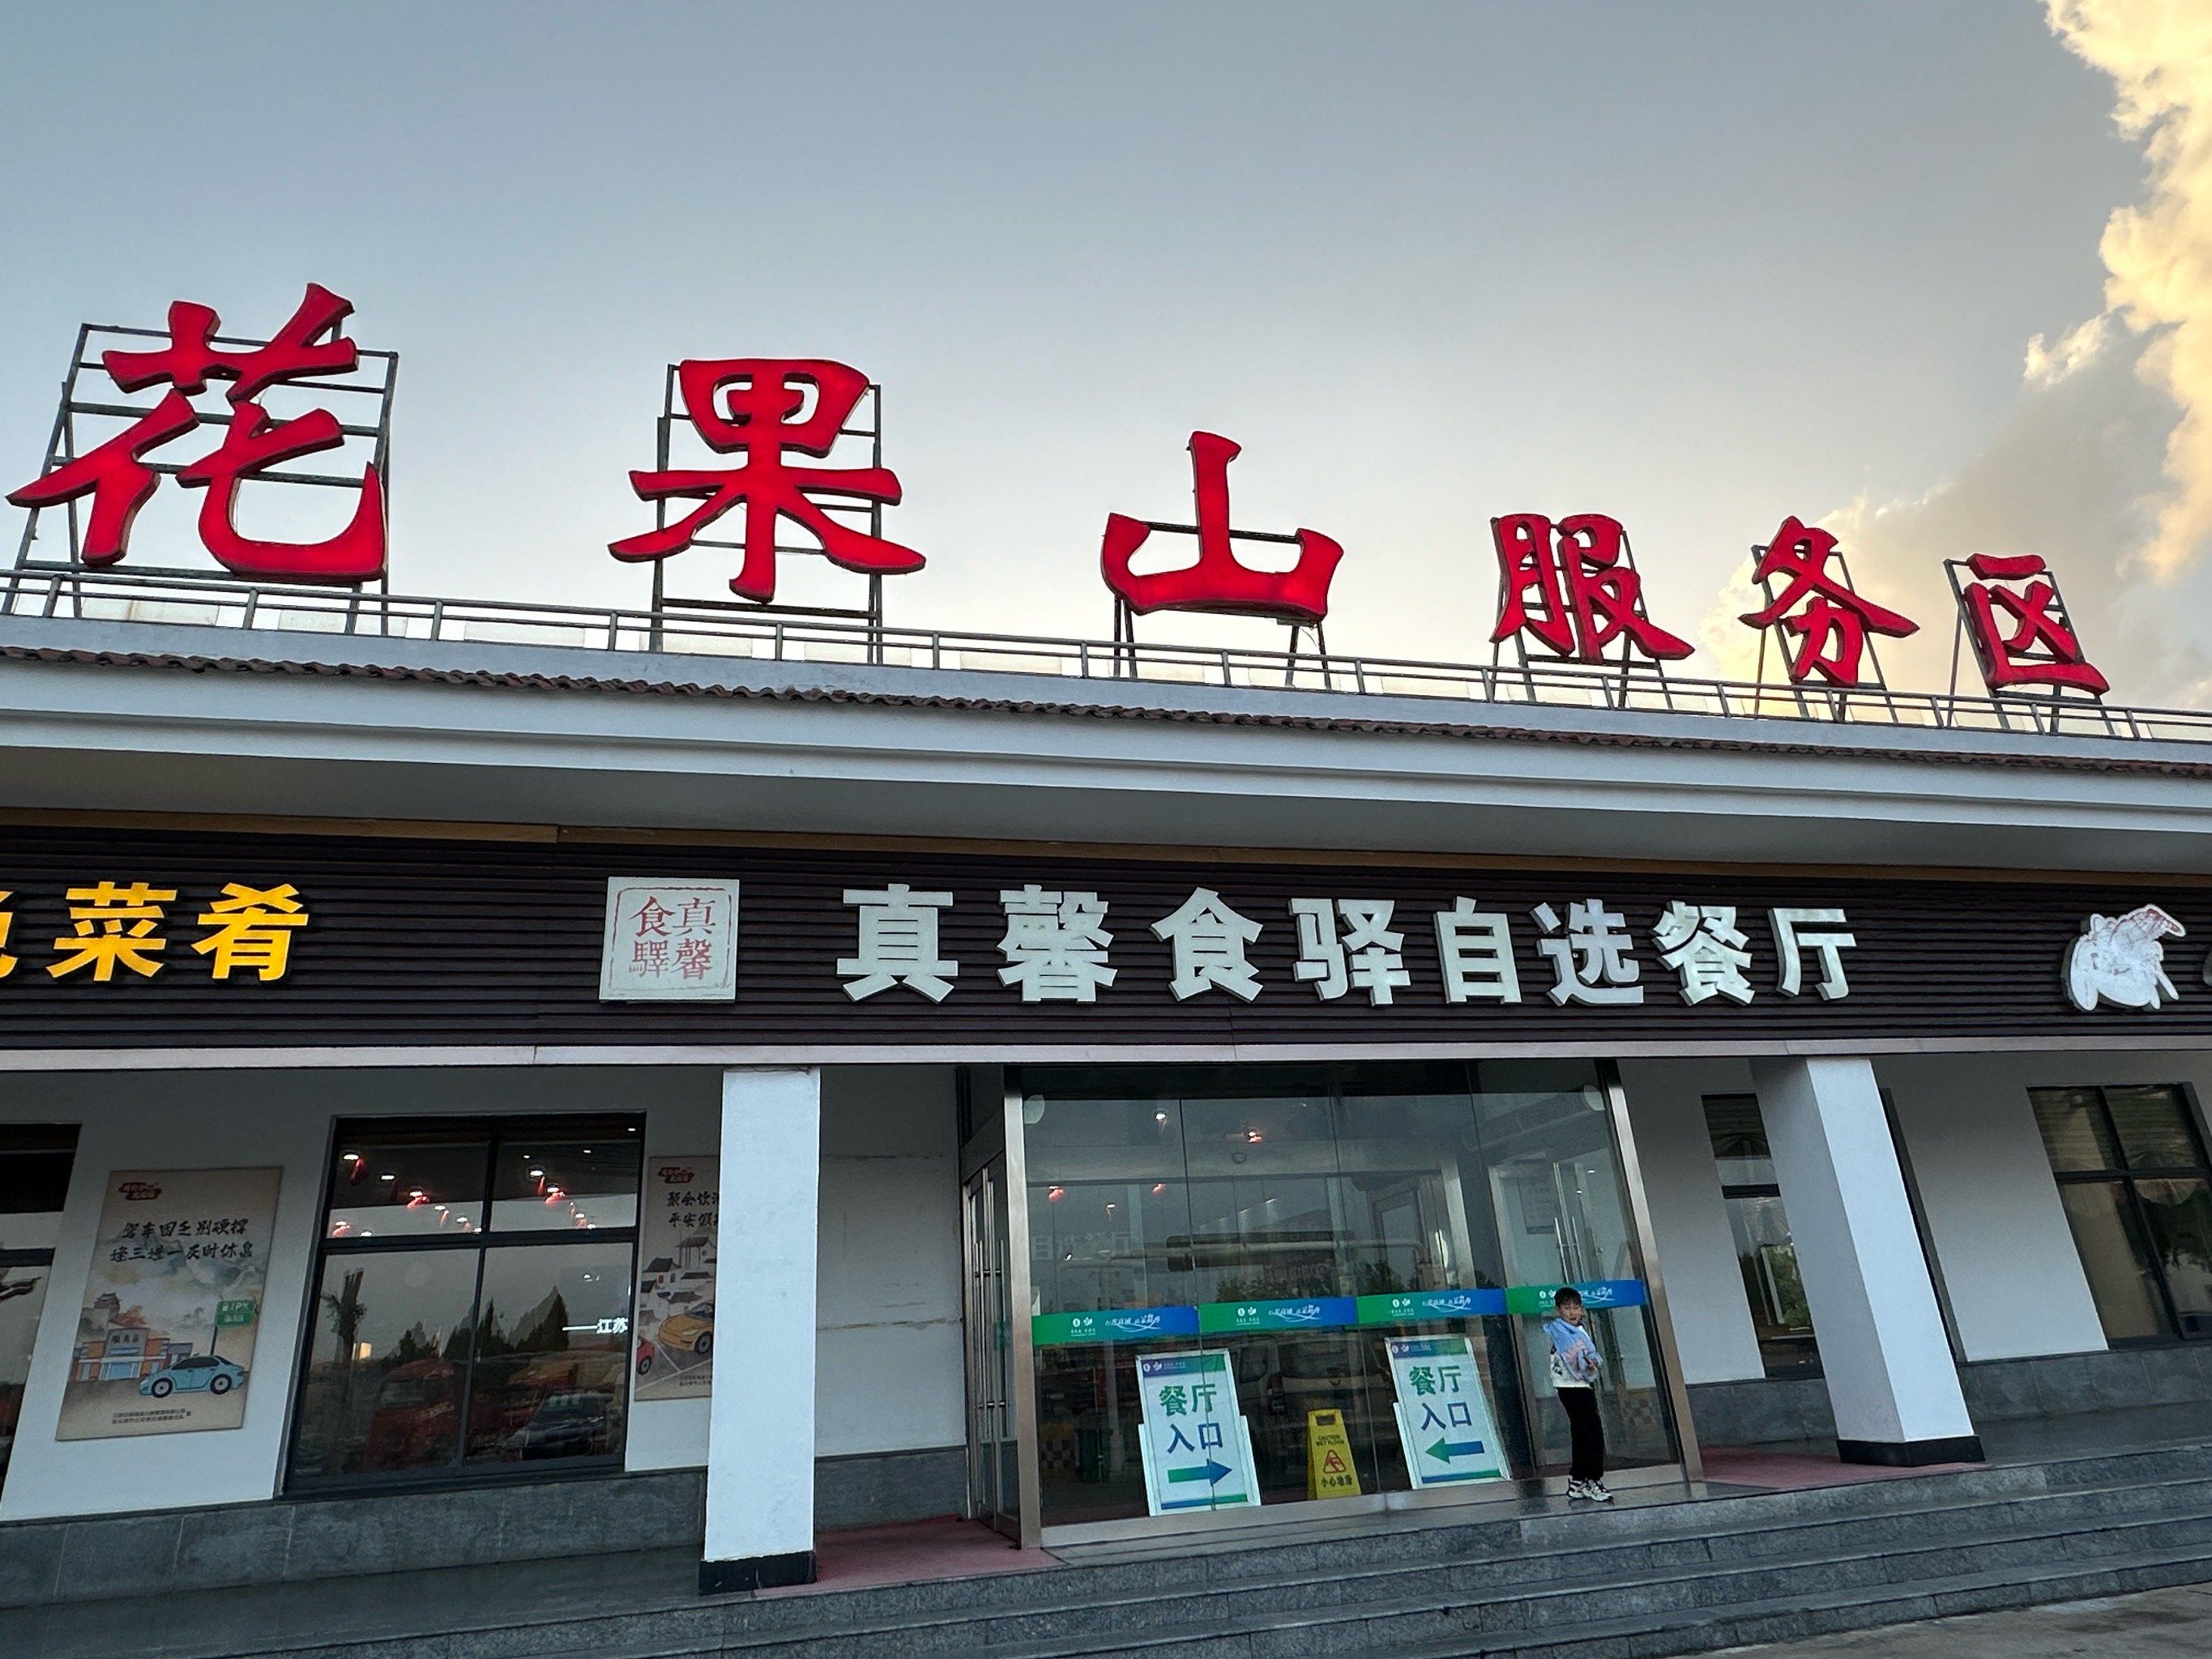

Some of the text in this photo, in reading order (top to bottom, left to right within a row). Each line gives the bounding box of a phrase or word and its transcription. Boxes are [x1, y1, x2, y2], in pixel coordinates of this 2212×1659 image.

[8, 283, 2112, 693] 花果山服务区
[0, 881, 310, 983] 菜肴
[836, 883, 1858, 1007] 真馨食驿自选餐厅
[1409, 1365, 1462, 1396] 餐厅
[1159, 1384, 1217, 1417] 餐厅
[1420, 1402, 1472, 1431] 入口
[1167, 1422, 1223, 1454] 入口
